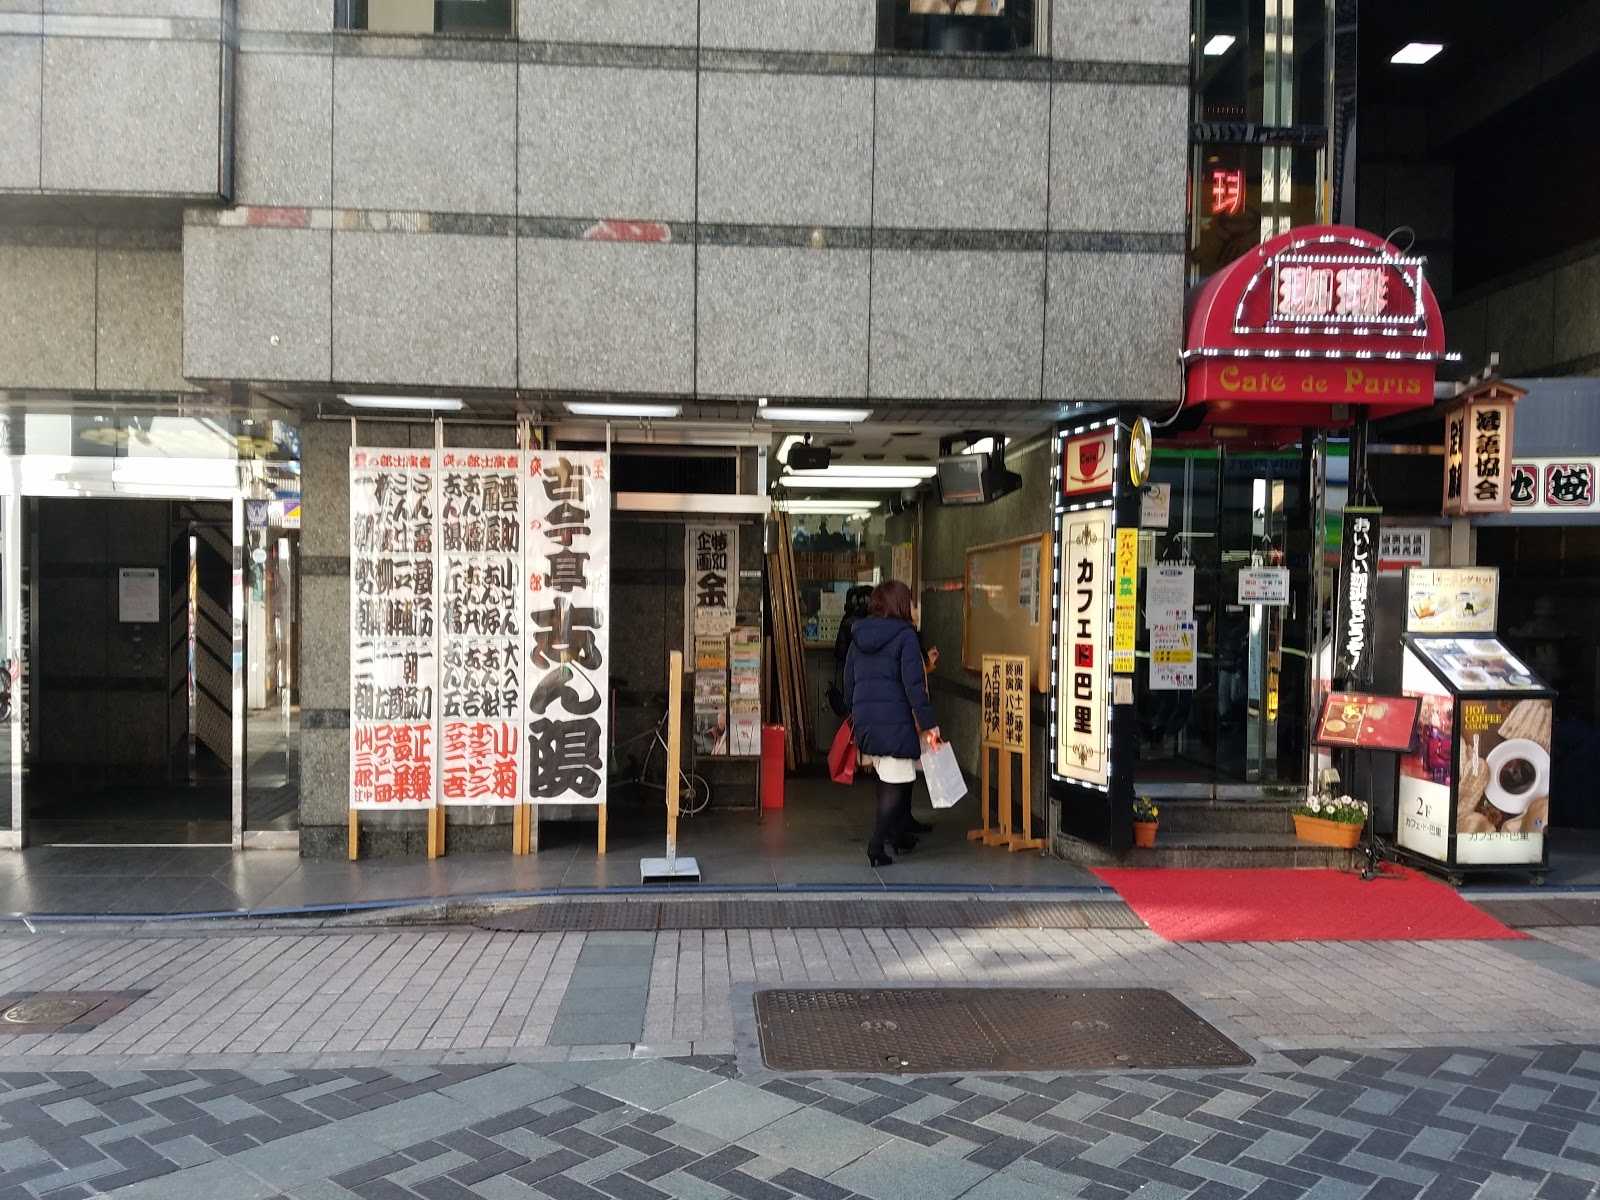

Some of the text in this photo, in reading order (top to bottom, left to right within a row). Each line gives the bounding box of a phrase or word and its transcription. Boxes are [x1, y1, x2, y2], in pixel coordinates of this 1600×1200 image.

[1301, 375, 1328, 392] de
[1344, 367, 1421, 394] Paris
[1465, 704, 1487, 714] HOT
[1465, 713, 1502, 724] COFFEE
[1415, 797, 1432, 818] 2F
